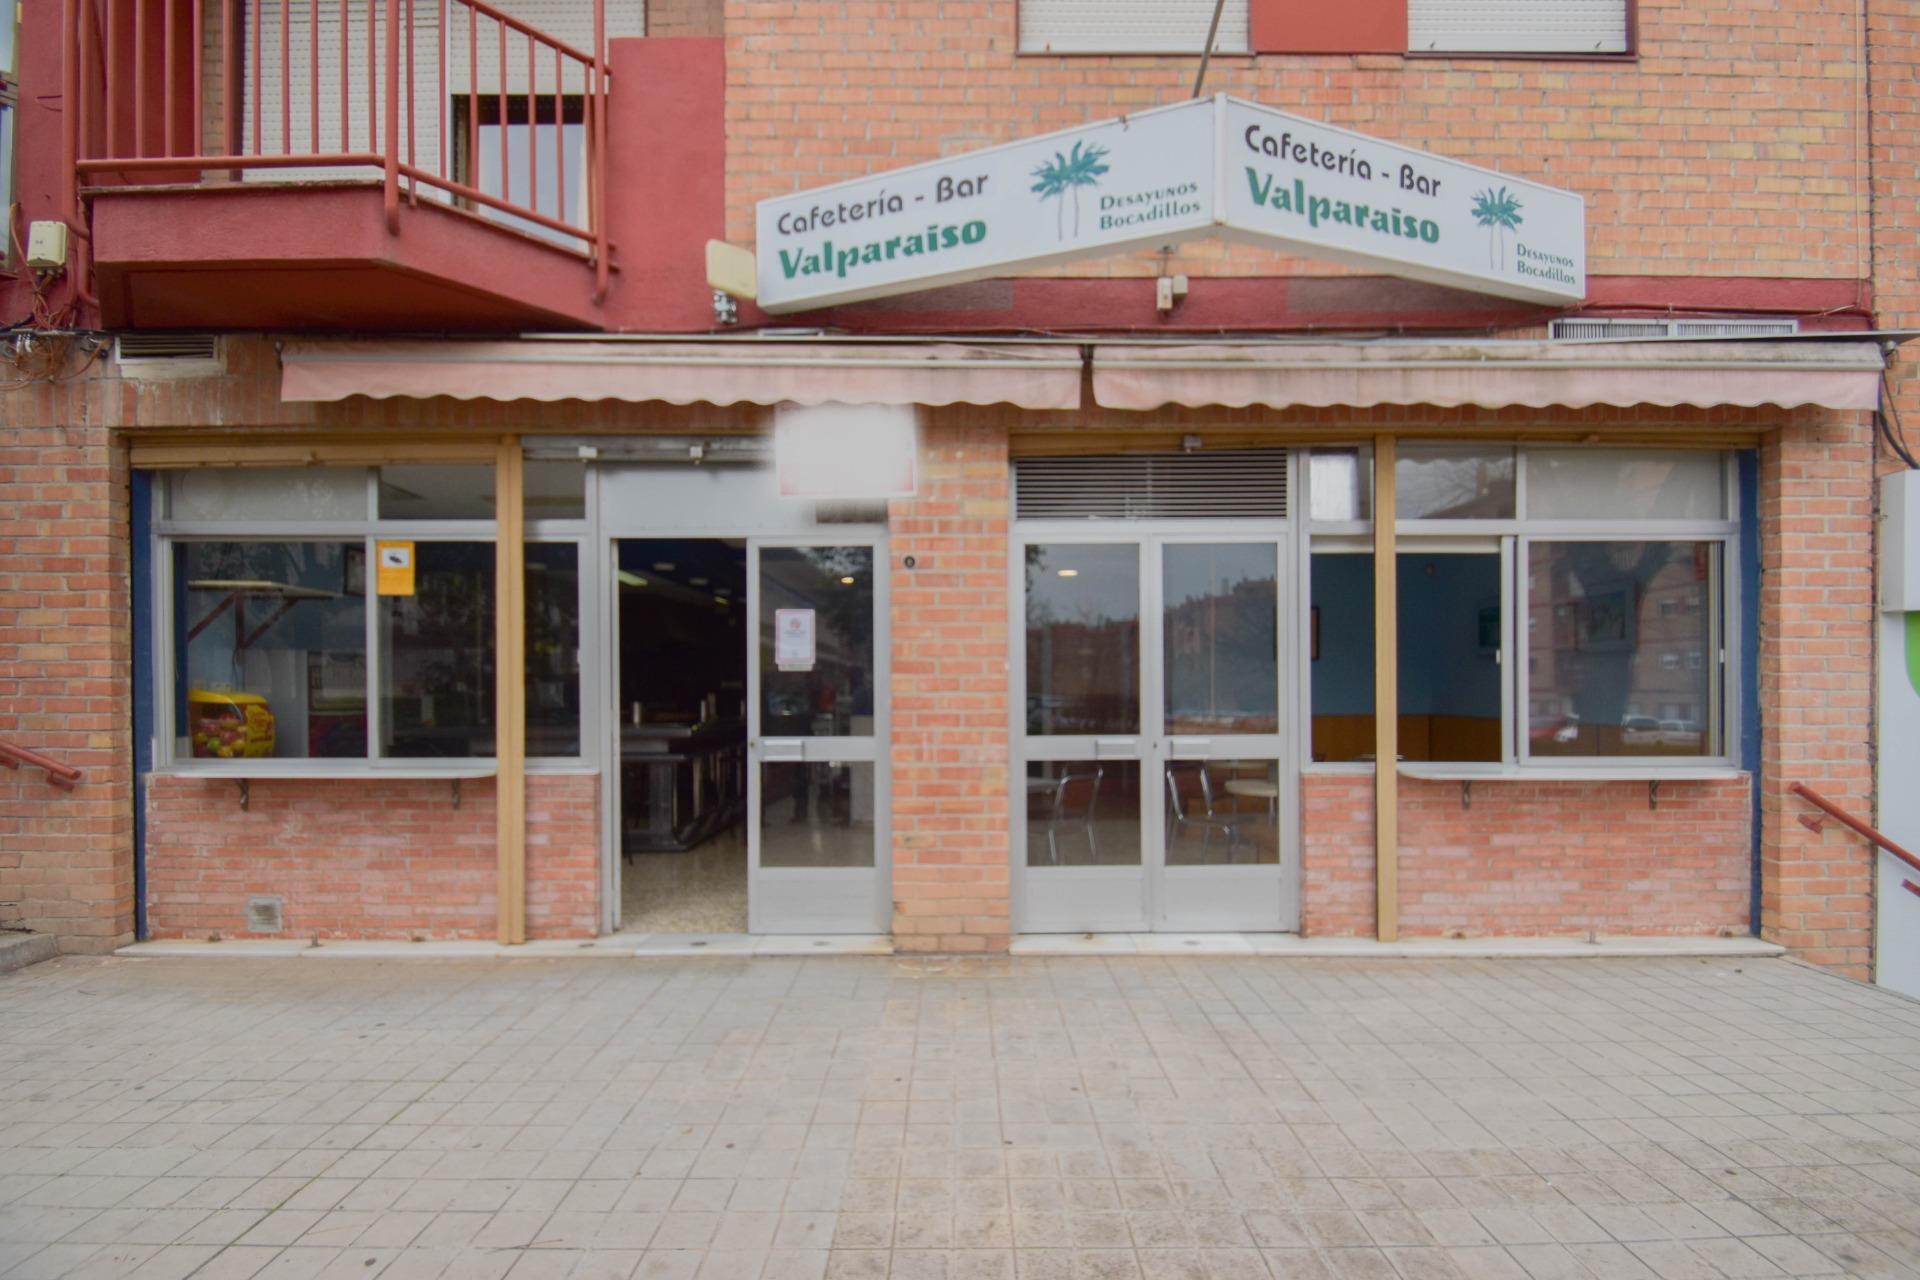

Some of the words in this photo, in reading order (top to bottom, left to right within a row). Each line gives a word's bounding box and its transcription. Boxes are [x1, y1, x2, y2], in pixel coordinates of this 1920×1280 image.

[1244, 124, 1372, 181] Cafetería
[1400, 163, 1442, 197] Bar
[777, 189, 903, 236] Cafetería
[936, 174, 989, 204] Bar
